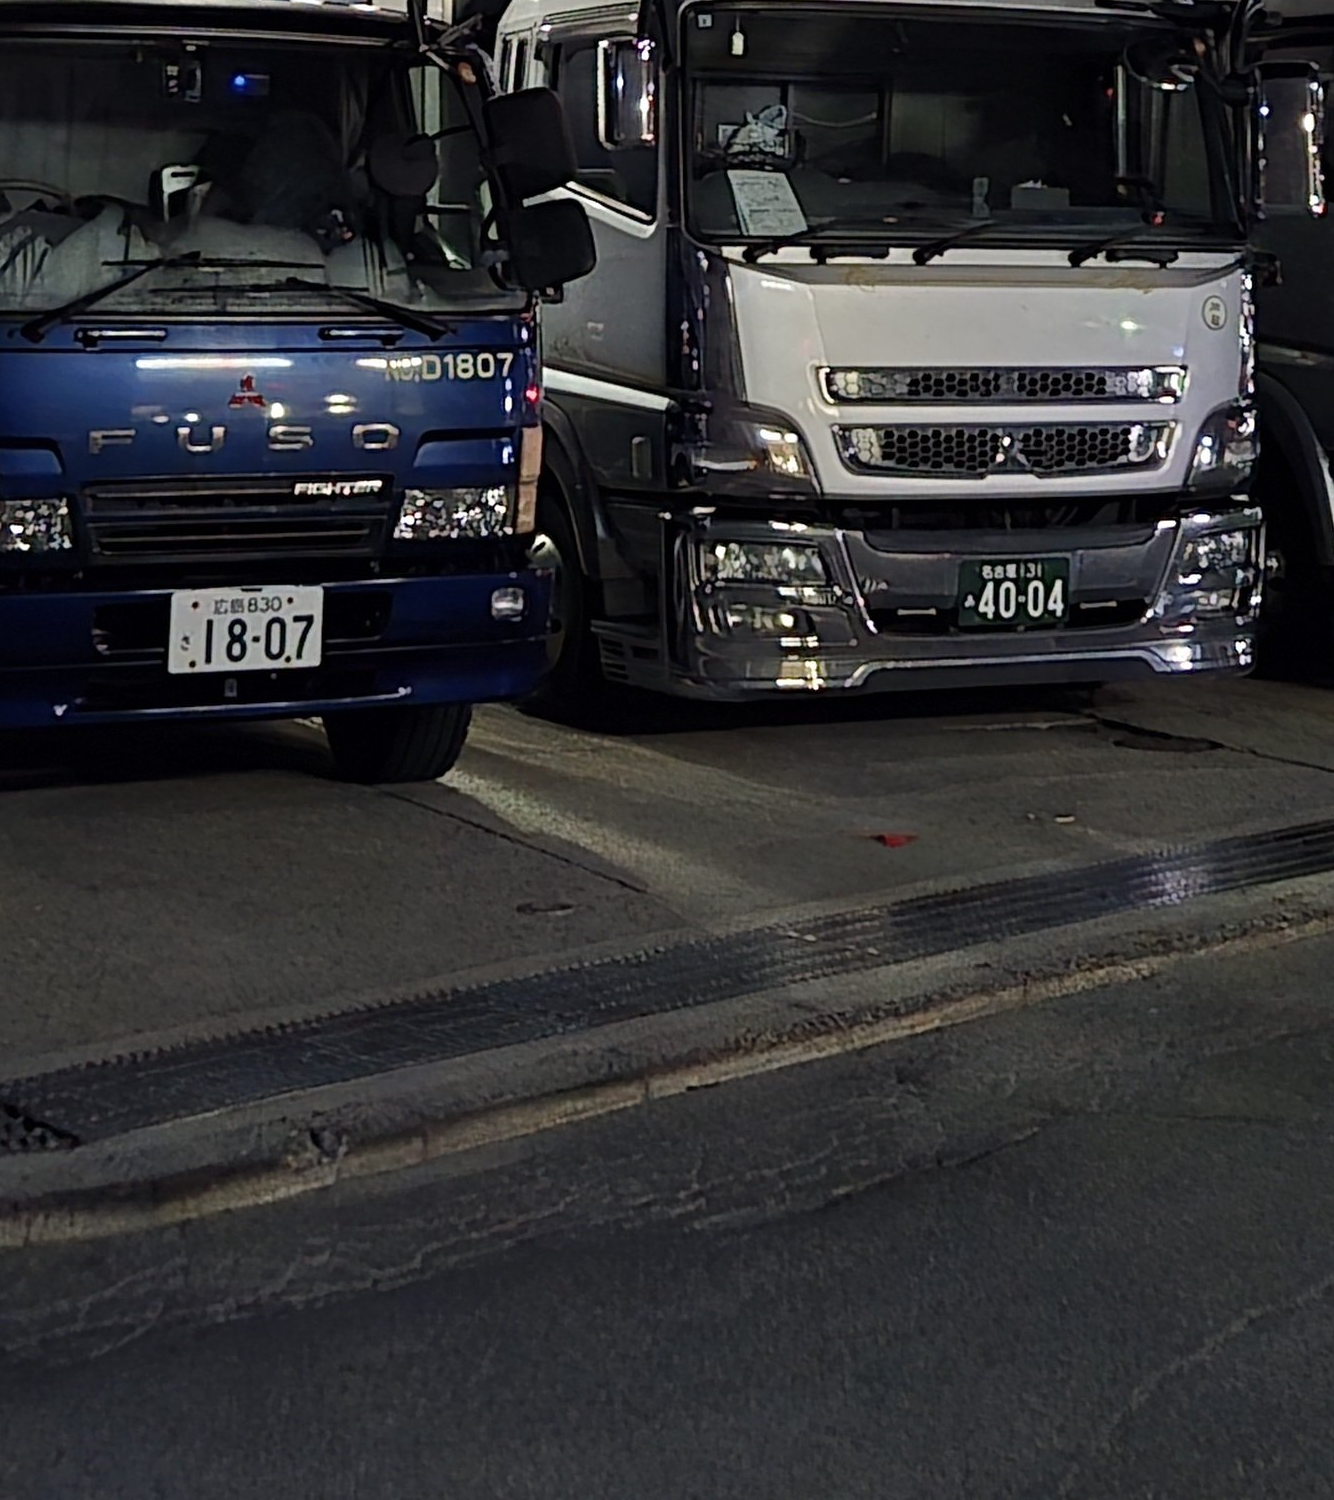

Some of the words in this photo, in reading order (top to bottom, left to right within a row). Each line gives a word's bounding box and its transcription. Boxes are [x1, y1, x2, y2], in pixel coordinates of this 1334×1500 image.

[89, 423, 401, 454] FUSO
[294, 479, 384, 496] FIGHTER
[978, 579, 1064, 619] 40-04
[204, 614, 314, 664] 18-07
